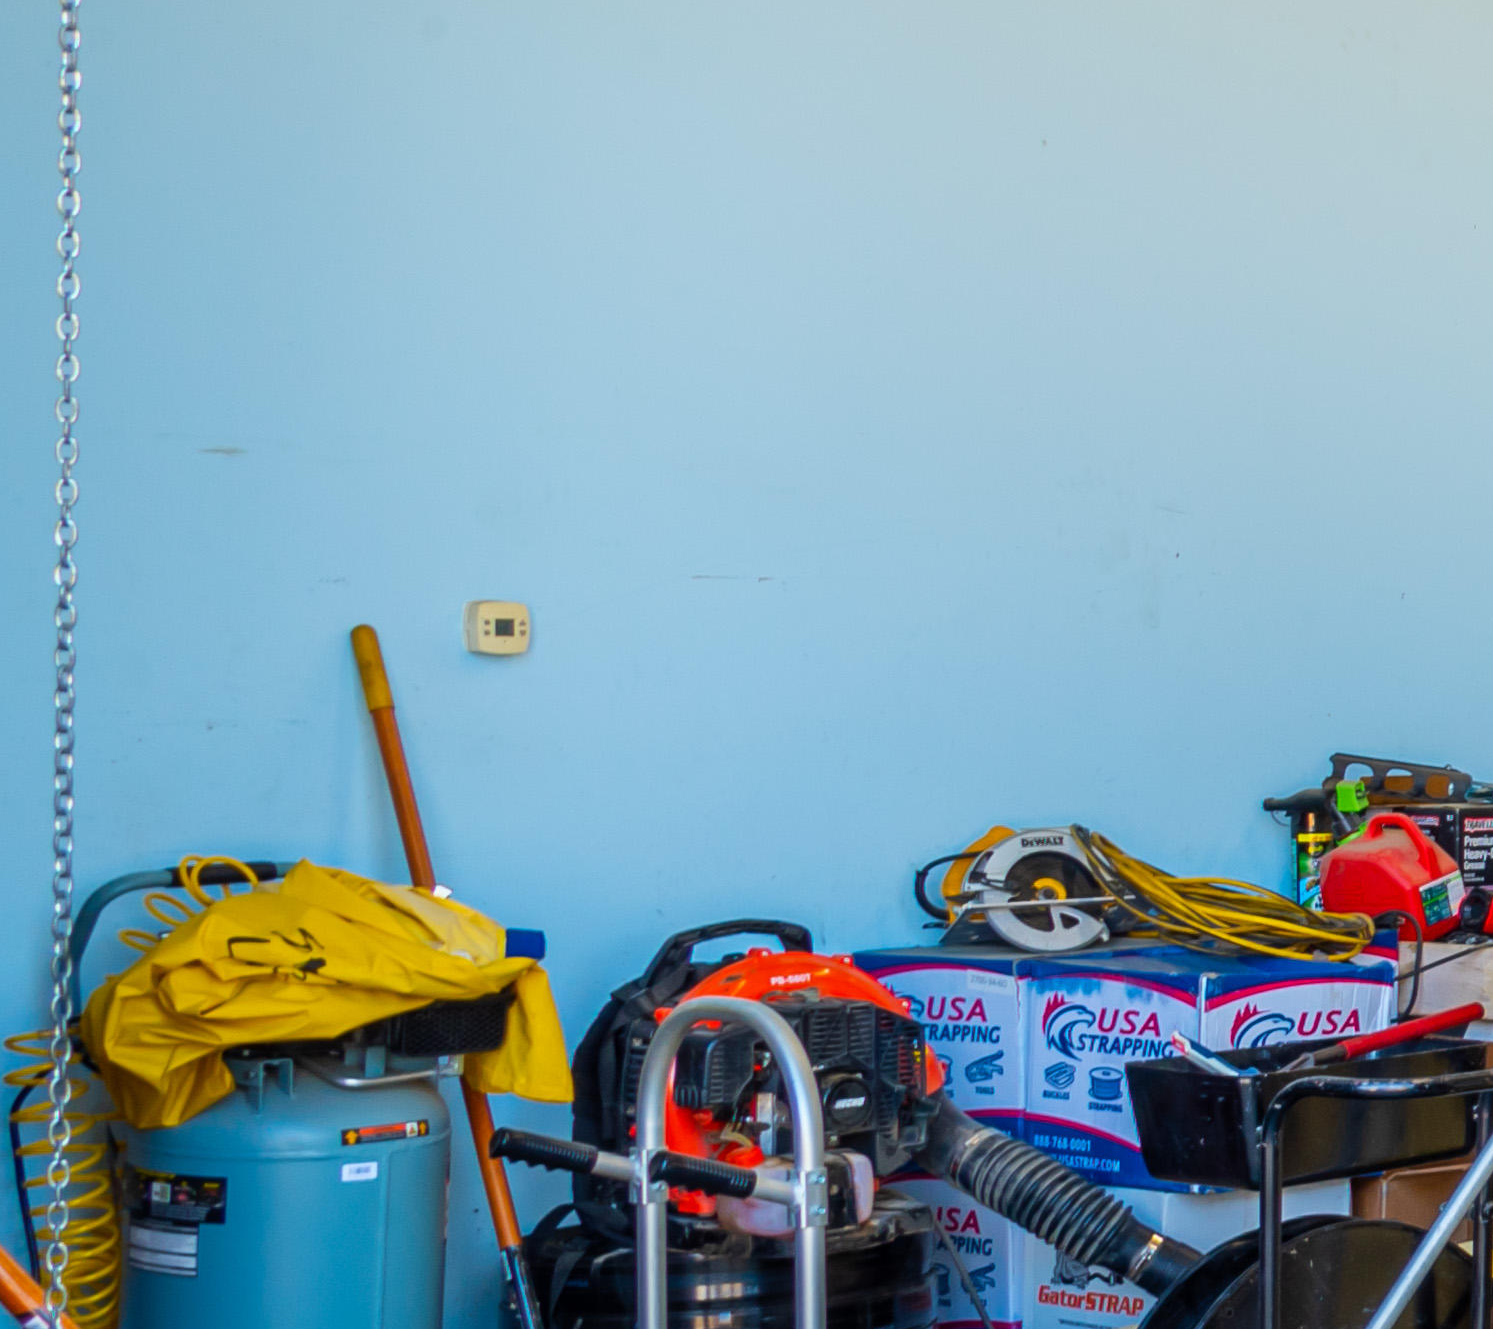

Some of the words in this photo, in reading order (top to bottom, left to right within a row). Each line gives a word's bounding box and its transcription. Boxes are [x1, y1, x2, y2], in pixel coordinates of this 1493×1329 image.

[926, 996, 988, 1023] USA
[1097, 1007, 1161, 1037] USA
[1297, 1008, 1361, 1037] USA
[922, 1024, 1001, 1044] TRAPPING
[1077, 1033, 1174, 1059] STRAPPING
[975, 1086, 995, 1096] TOOLS
[1088, 1102, 1123, 1113] STRAPPING
[1034, 1134, 1091, 1152] 888-768-0001
[1038, 1285, 1144, 1316] GatorSTRAP
